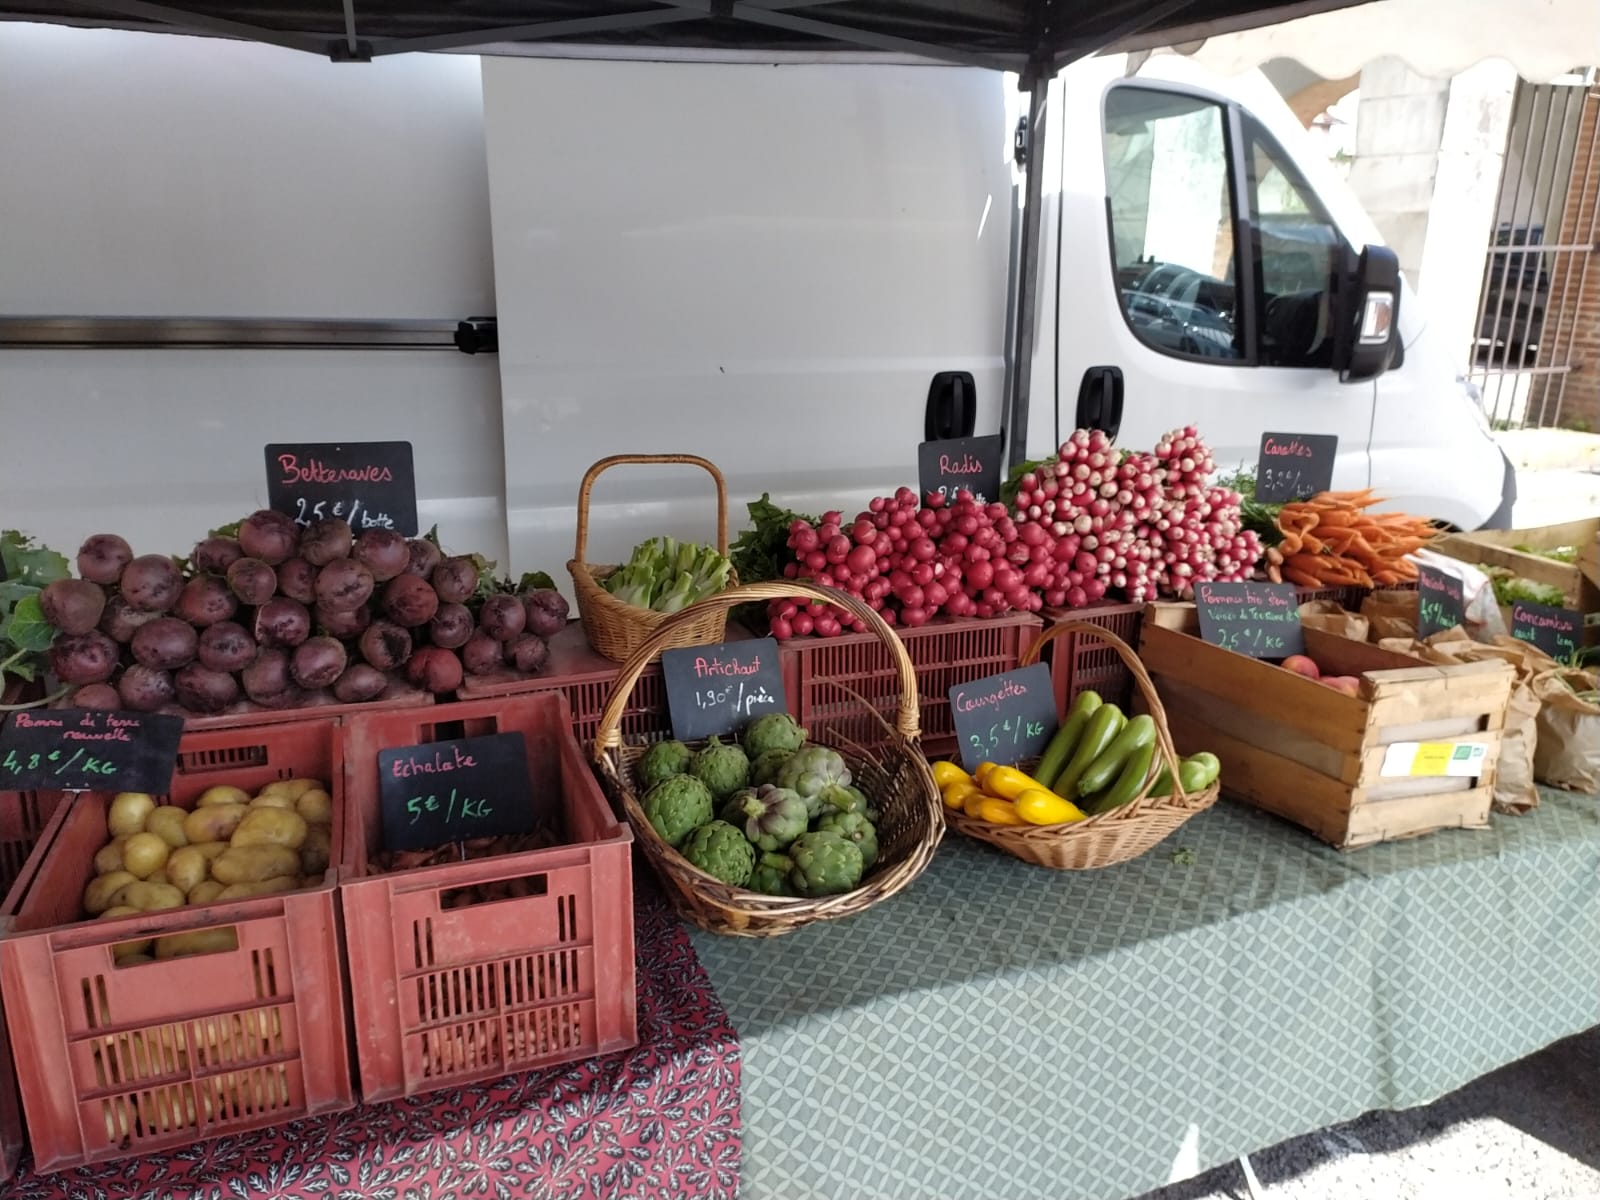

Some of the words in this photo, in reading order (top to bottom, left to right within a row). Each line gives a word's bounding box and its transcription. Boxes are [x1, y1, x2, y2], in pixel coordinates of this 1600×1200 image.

[939, 453, 982, 475] Radis
[694, 655, 761, 678] Artichaut
[956, 679, 1028, 712] Courgettes
